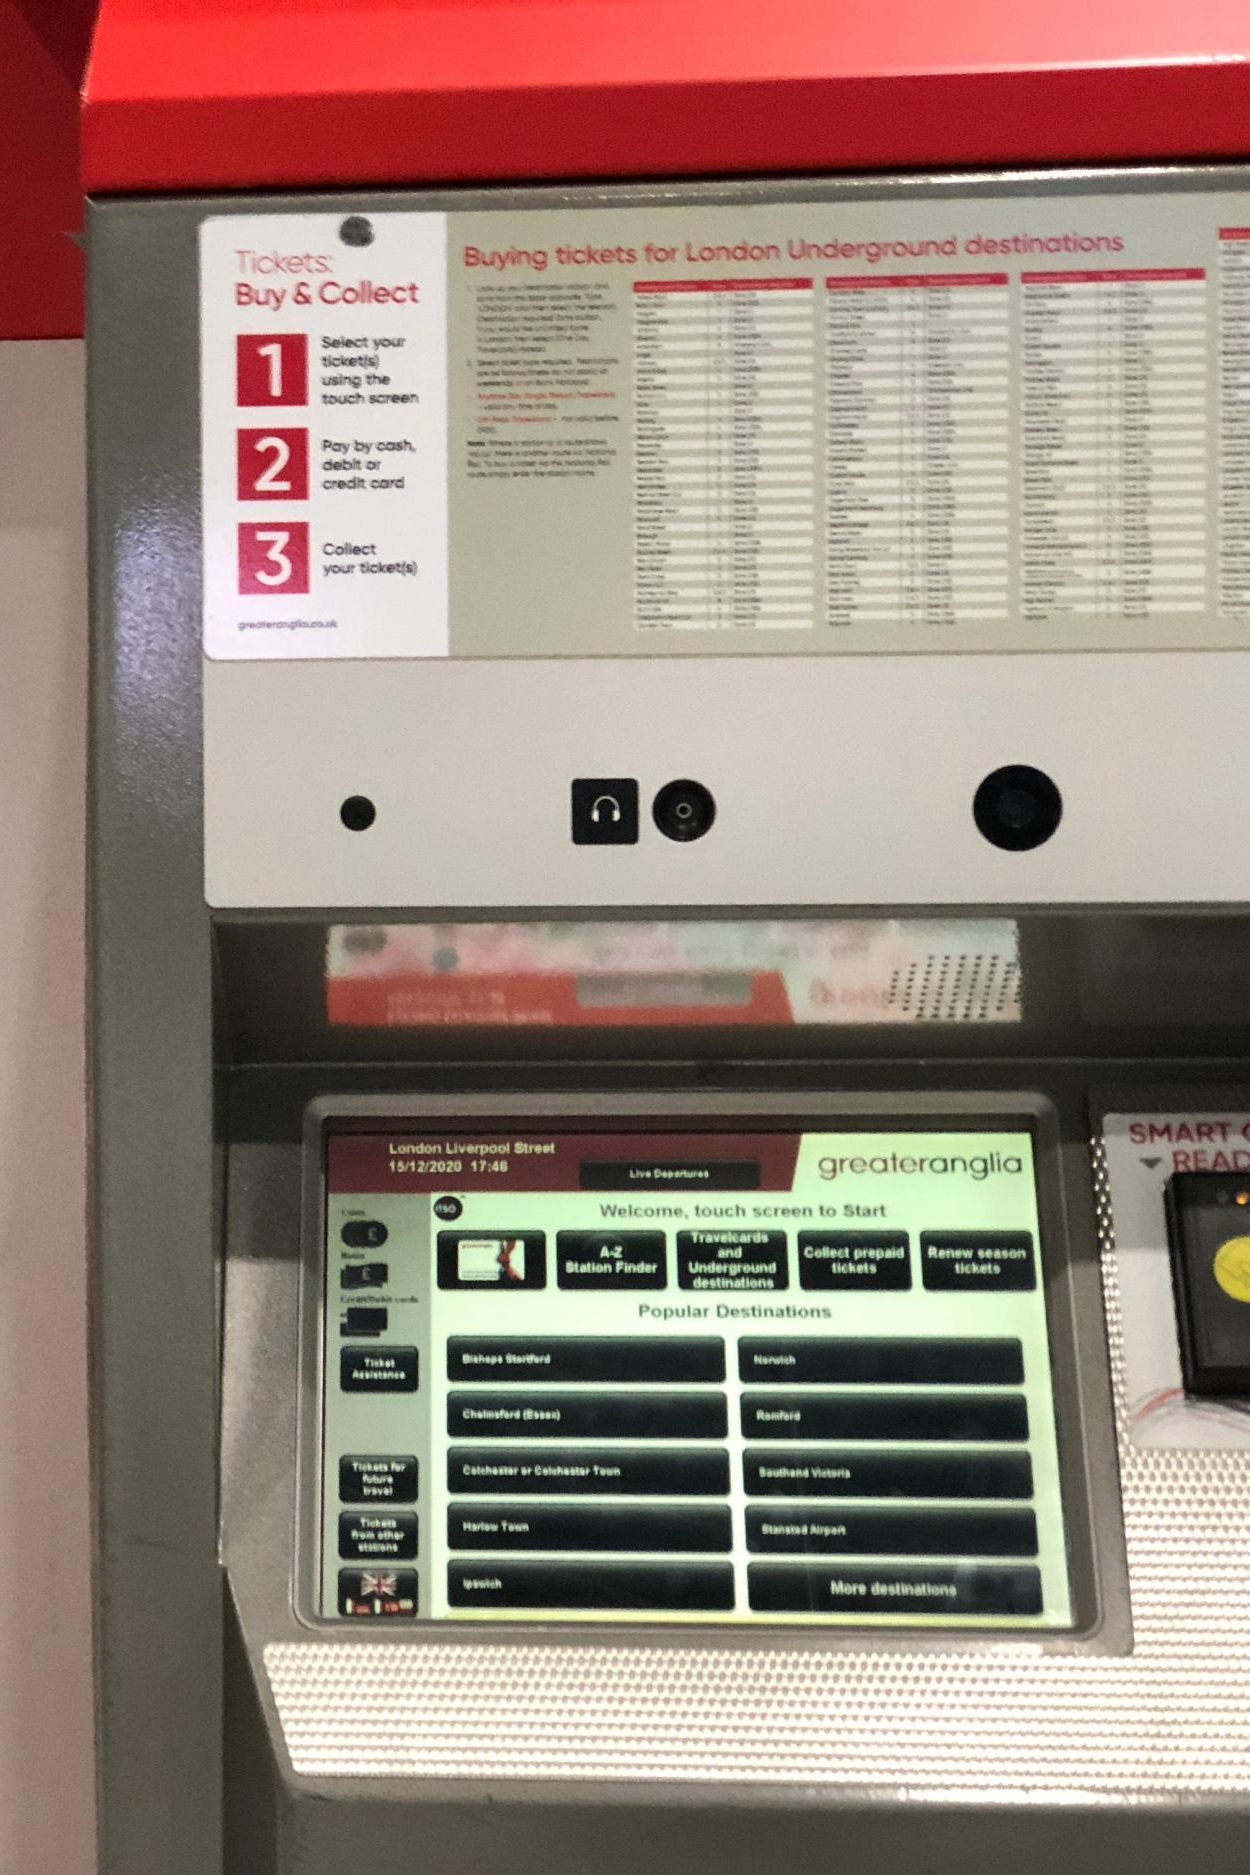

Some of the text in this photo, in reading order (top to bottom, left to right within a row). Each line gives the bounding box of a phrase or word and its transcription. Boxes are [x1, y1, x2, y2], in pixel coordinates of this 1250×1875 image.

[464, 232, 1125, 271] Buying tickets for London Underground destinations
[234, 281, 420, 309] Buy & Collect
[322, 335, 406, 352] Select your
[322, 354, 379, 370] ticket(s)
[257, 343, 283, 397] 1
[322, 372, 390, 389] using the
[322, 391, 419, 405] touch screen
[322, 439, 417, 456] Pay by cash,
[253, 436, 291, 492] 2
[322, 458, 382, 472] debit or
[322, 476, 405, 491] credit card
[323, 543, 376, 557] Collect
[254, 531, 292, 585] 3
[323, 561, 417, 577] your ticket(s)
[1129, 1122, 1231, 1144] SMART
[389, 1142, 555, 1156] London Liverpool Street
[389, 1160, 462, 1173] 15/12/2020
[819, 1152, 1022, 1180] greateranglia
[630, 1168, 709, 1180] Live Departures
[600, 1204, 886, 1219] Welcome, touch screen to Start
[693, 1232, 768, 1244] Travelcards
[600, 1246, 623, 1259] A-Z
[717, 1247, 742, 1259] and
[804, 1247, 904, 1262] Collect prepaid
[928, 1247, 1026, 1259] Renew season
[566, 1261, 657, 1274] Station Finder
[689, 1261, 776, 1276] Underground
[832, 1262, 877, 1274] tickets
[955, 1262, 1000, 1274] tickets
[693, 1276, 774, 1289] destinations
[639, 1304, 832, 1320] Popular Destinations
[364, 1358, 395, 1368] Ticket
[462, 1353, 551, 1366] Bishops Stortford
[754, 1354, 796, 1366] Norwich
[352, 1370, 406, 1379] Assistance
[462, 1409, 561, 1421] Chelmsford (Essex)
[756, 1409, 801, 1422] Romford
[352, 1462, 406, 1472] Tickets for
[462, 1465, 620, 1477] Colchester or Colchester Town
[759, 1467, 851, 1479] Southend Victoria
[362, 1473, 394, 1484] future
[363, 1485, 393, 1496] travel
[360, 1517, 397, 1528] Tickets
[462, 1521, 529, 1533] Harlow Town
[351, 1529, 404, 1539] from other
[761, 1524, 846, 1537] Stansted Airport
[358, 1542, 399, 1552] stations
[463, 1578, 502, 1591] Ipswich
[831, 1581, 957, 1597] More destinations
